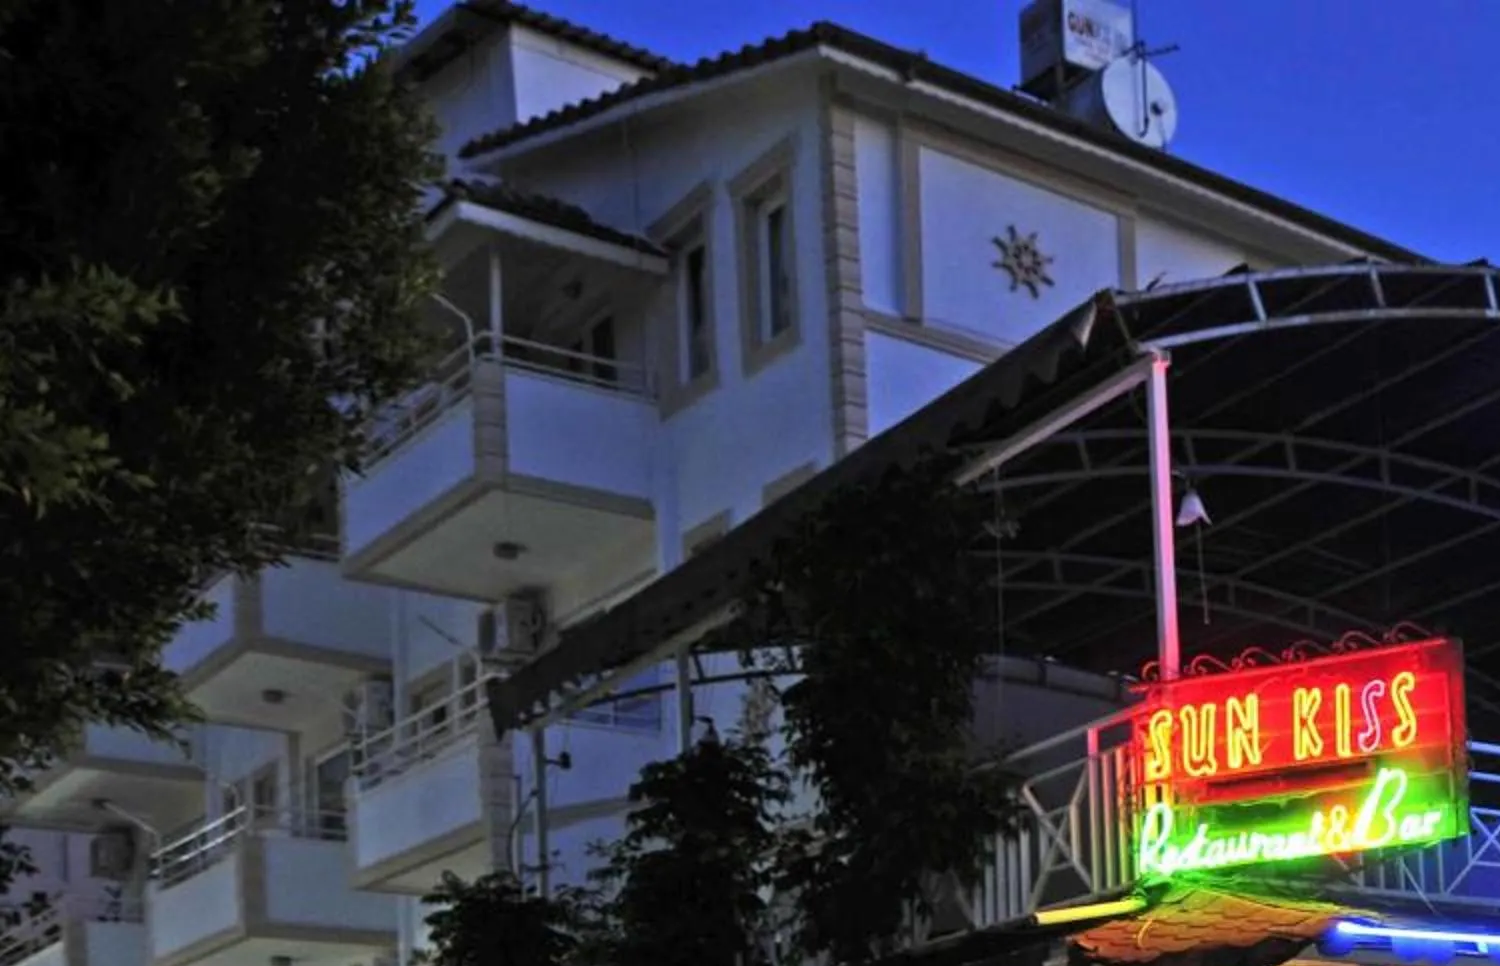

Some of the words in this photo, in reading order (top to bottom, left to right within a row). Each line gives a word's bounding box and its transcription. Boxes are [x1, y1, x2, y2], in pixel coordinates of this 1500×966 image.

[1147, 692, 1262, 780] SUN
[1293, 670, 1418, 759] KISS
[1140, 800, 1324, 876] Restaurant
[1325, 804, 1353, 852] &
[1352, 767, 1443, 850] Bar
